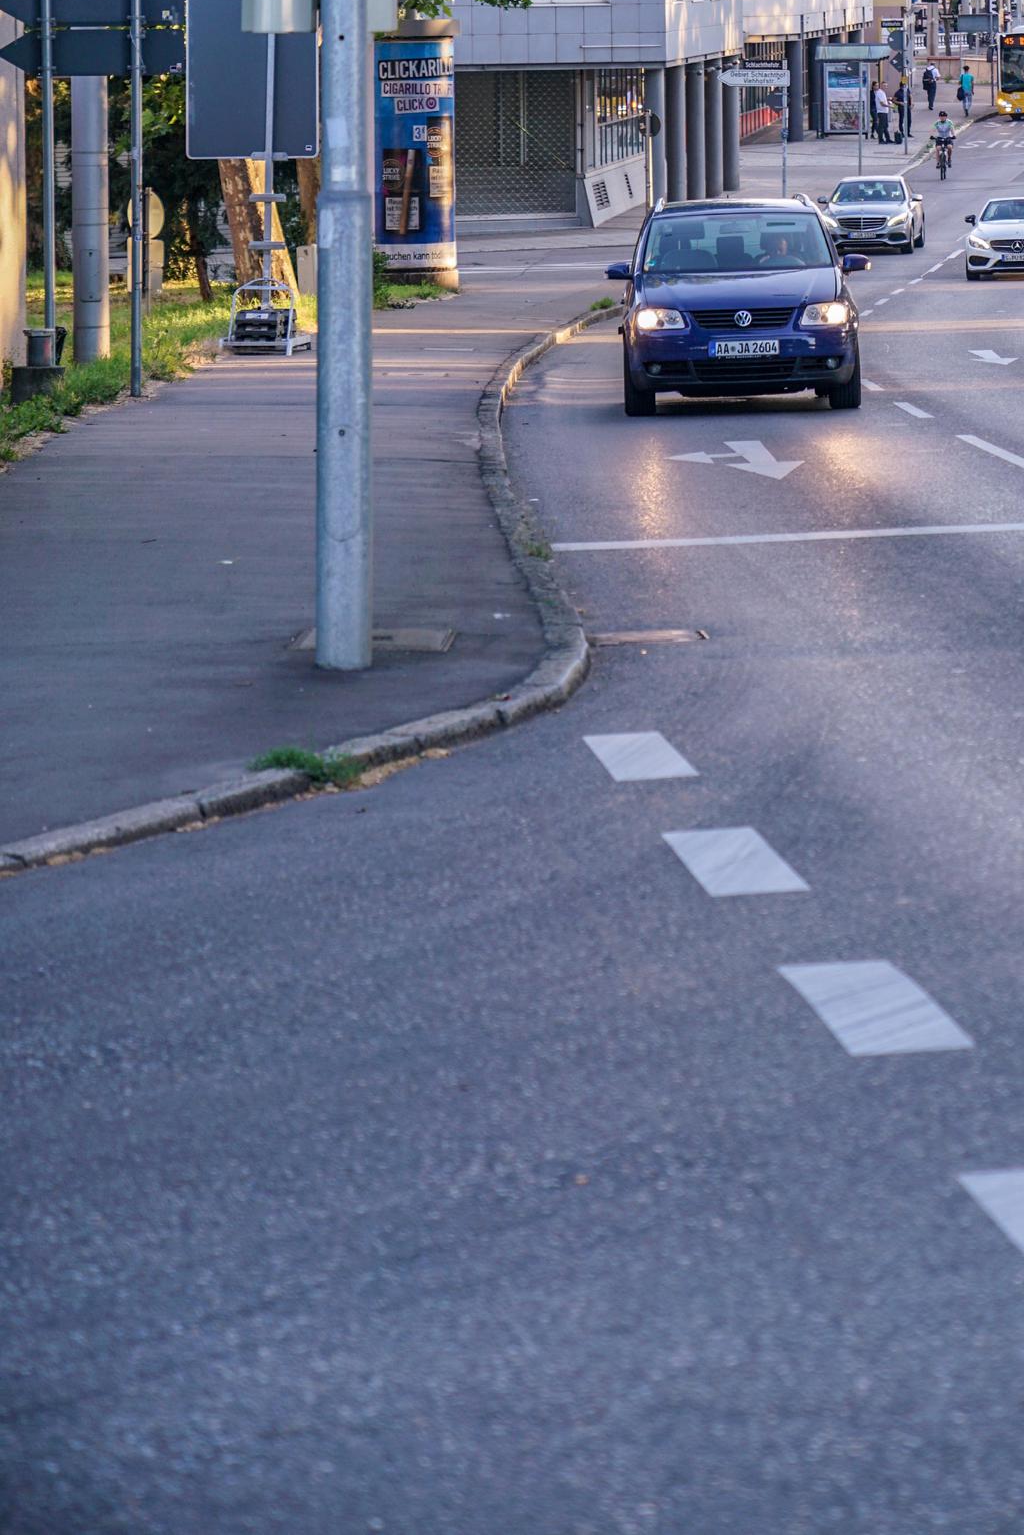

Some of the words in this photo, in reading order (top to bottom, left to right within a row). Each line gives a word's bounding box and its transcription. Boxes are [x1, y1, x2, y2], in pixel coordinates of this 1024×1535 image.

[1004, 37, 1014, 45] 45
[383, 83, 431, 95] CIGARILLO
[397, 98, 425, 111] CLICK
[413, 251, 429, 260] kann
[752, 341, 777, 353] 2604
